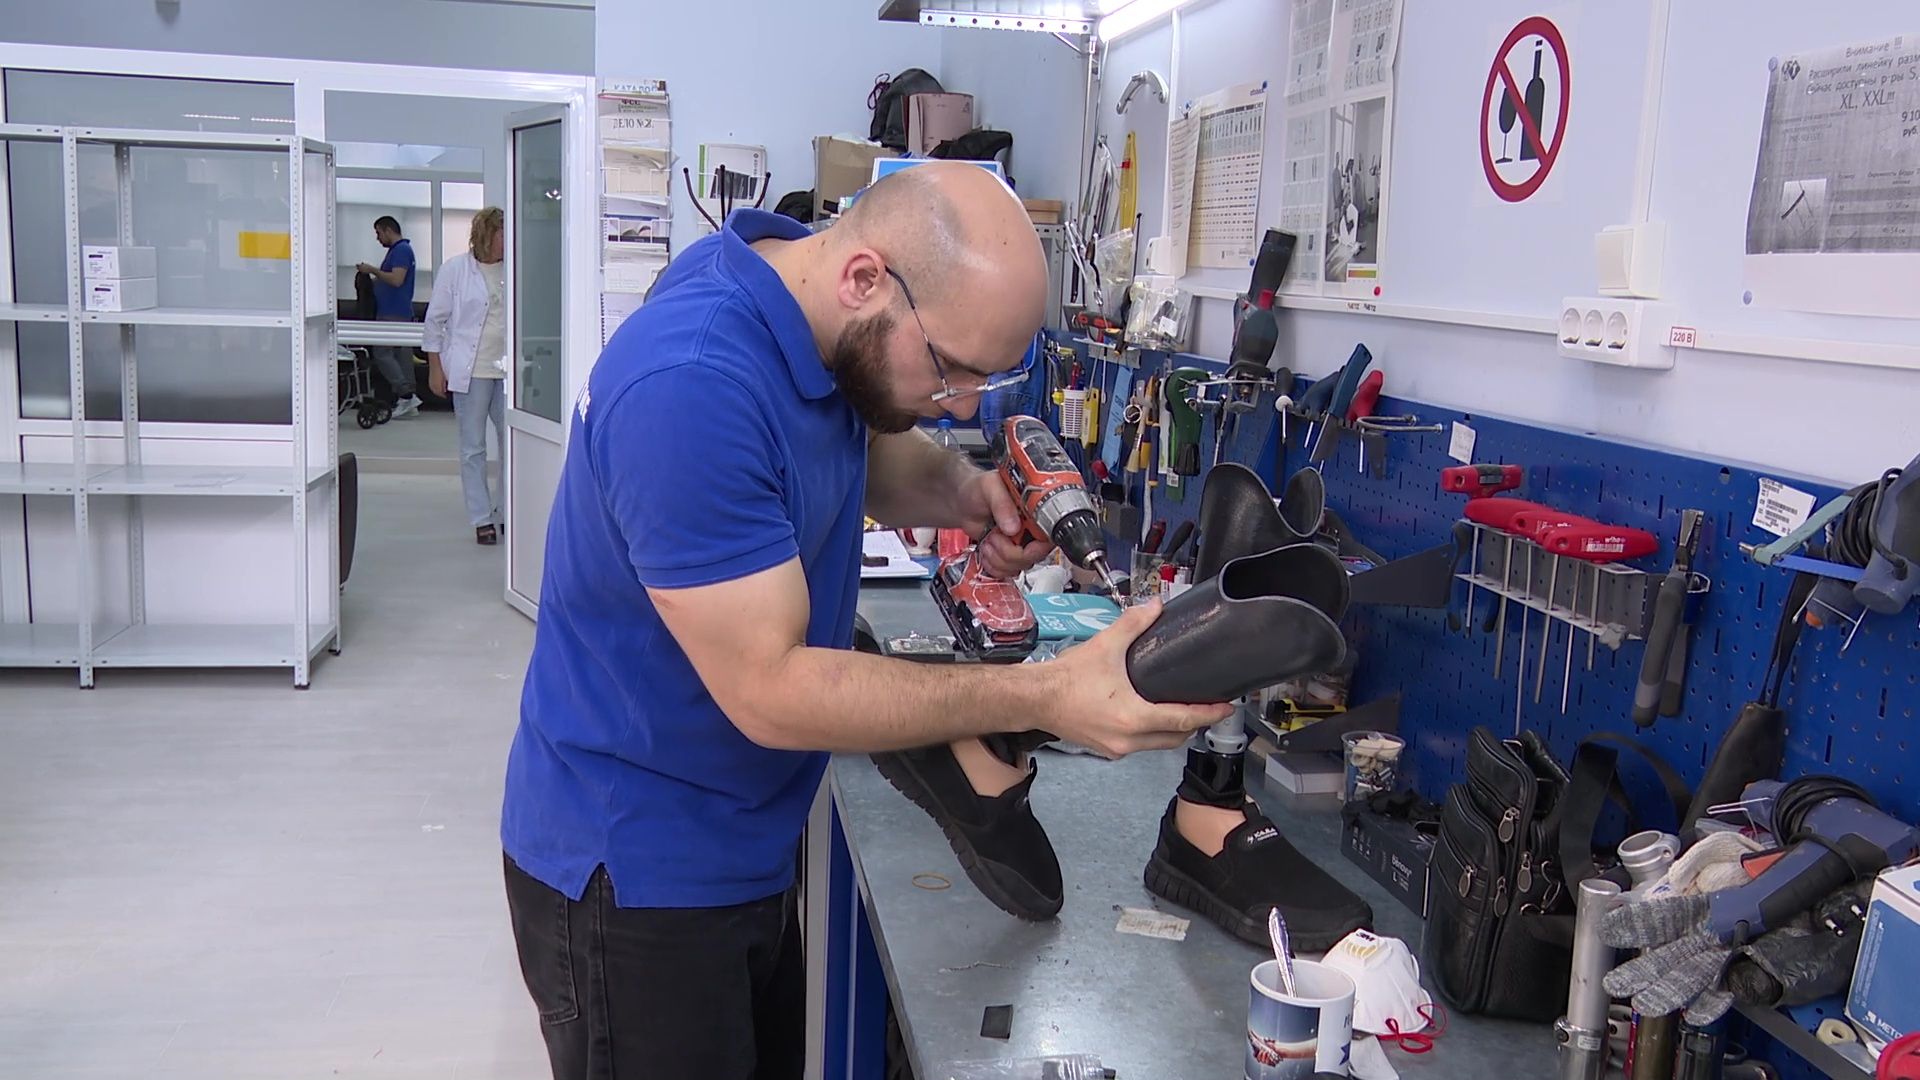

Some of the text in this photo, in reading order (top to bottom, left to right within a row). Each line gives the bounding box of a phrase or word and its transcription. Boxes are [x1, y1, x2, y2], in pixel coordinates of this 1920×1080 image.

[1846, 42, 1889, 58] Внимание
[1856, 56, 1893, 73] линейку
[1840, 94, 1858, 110] XL,
[1673, 332, 1685, 342] 220
